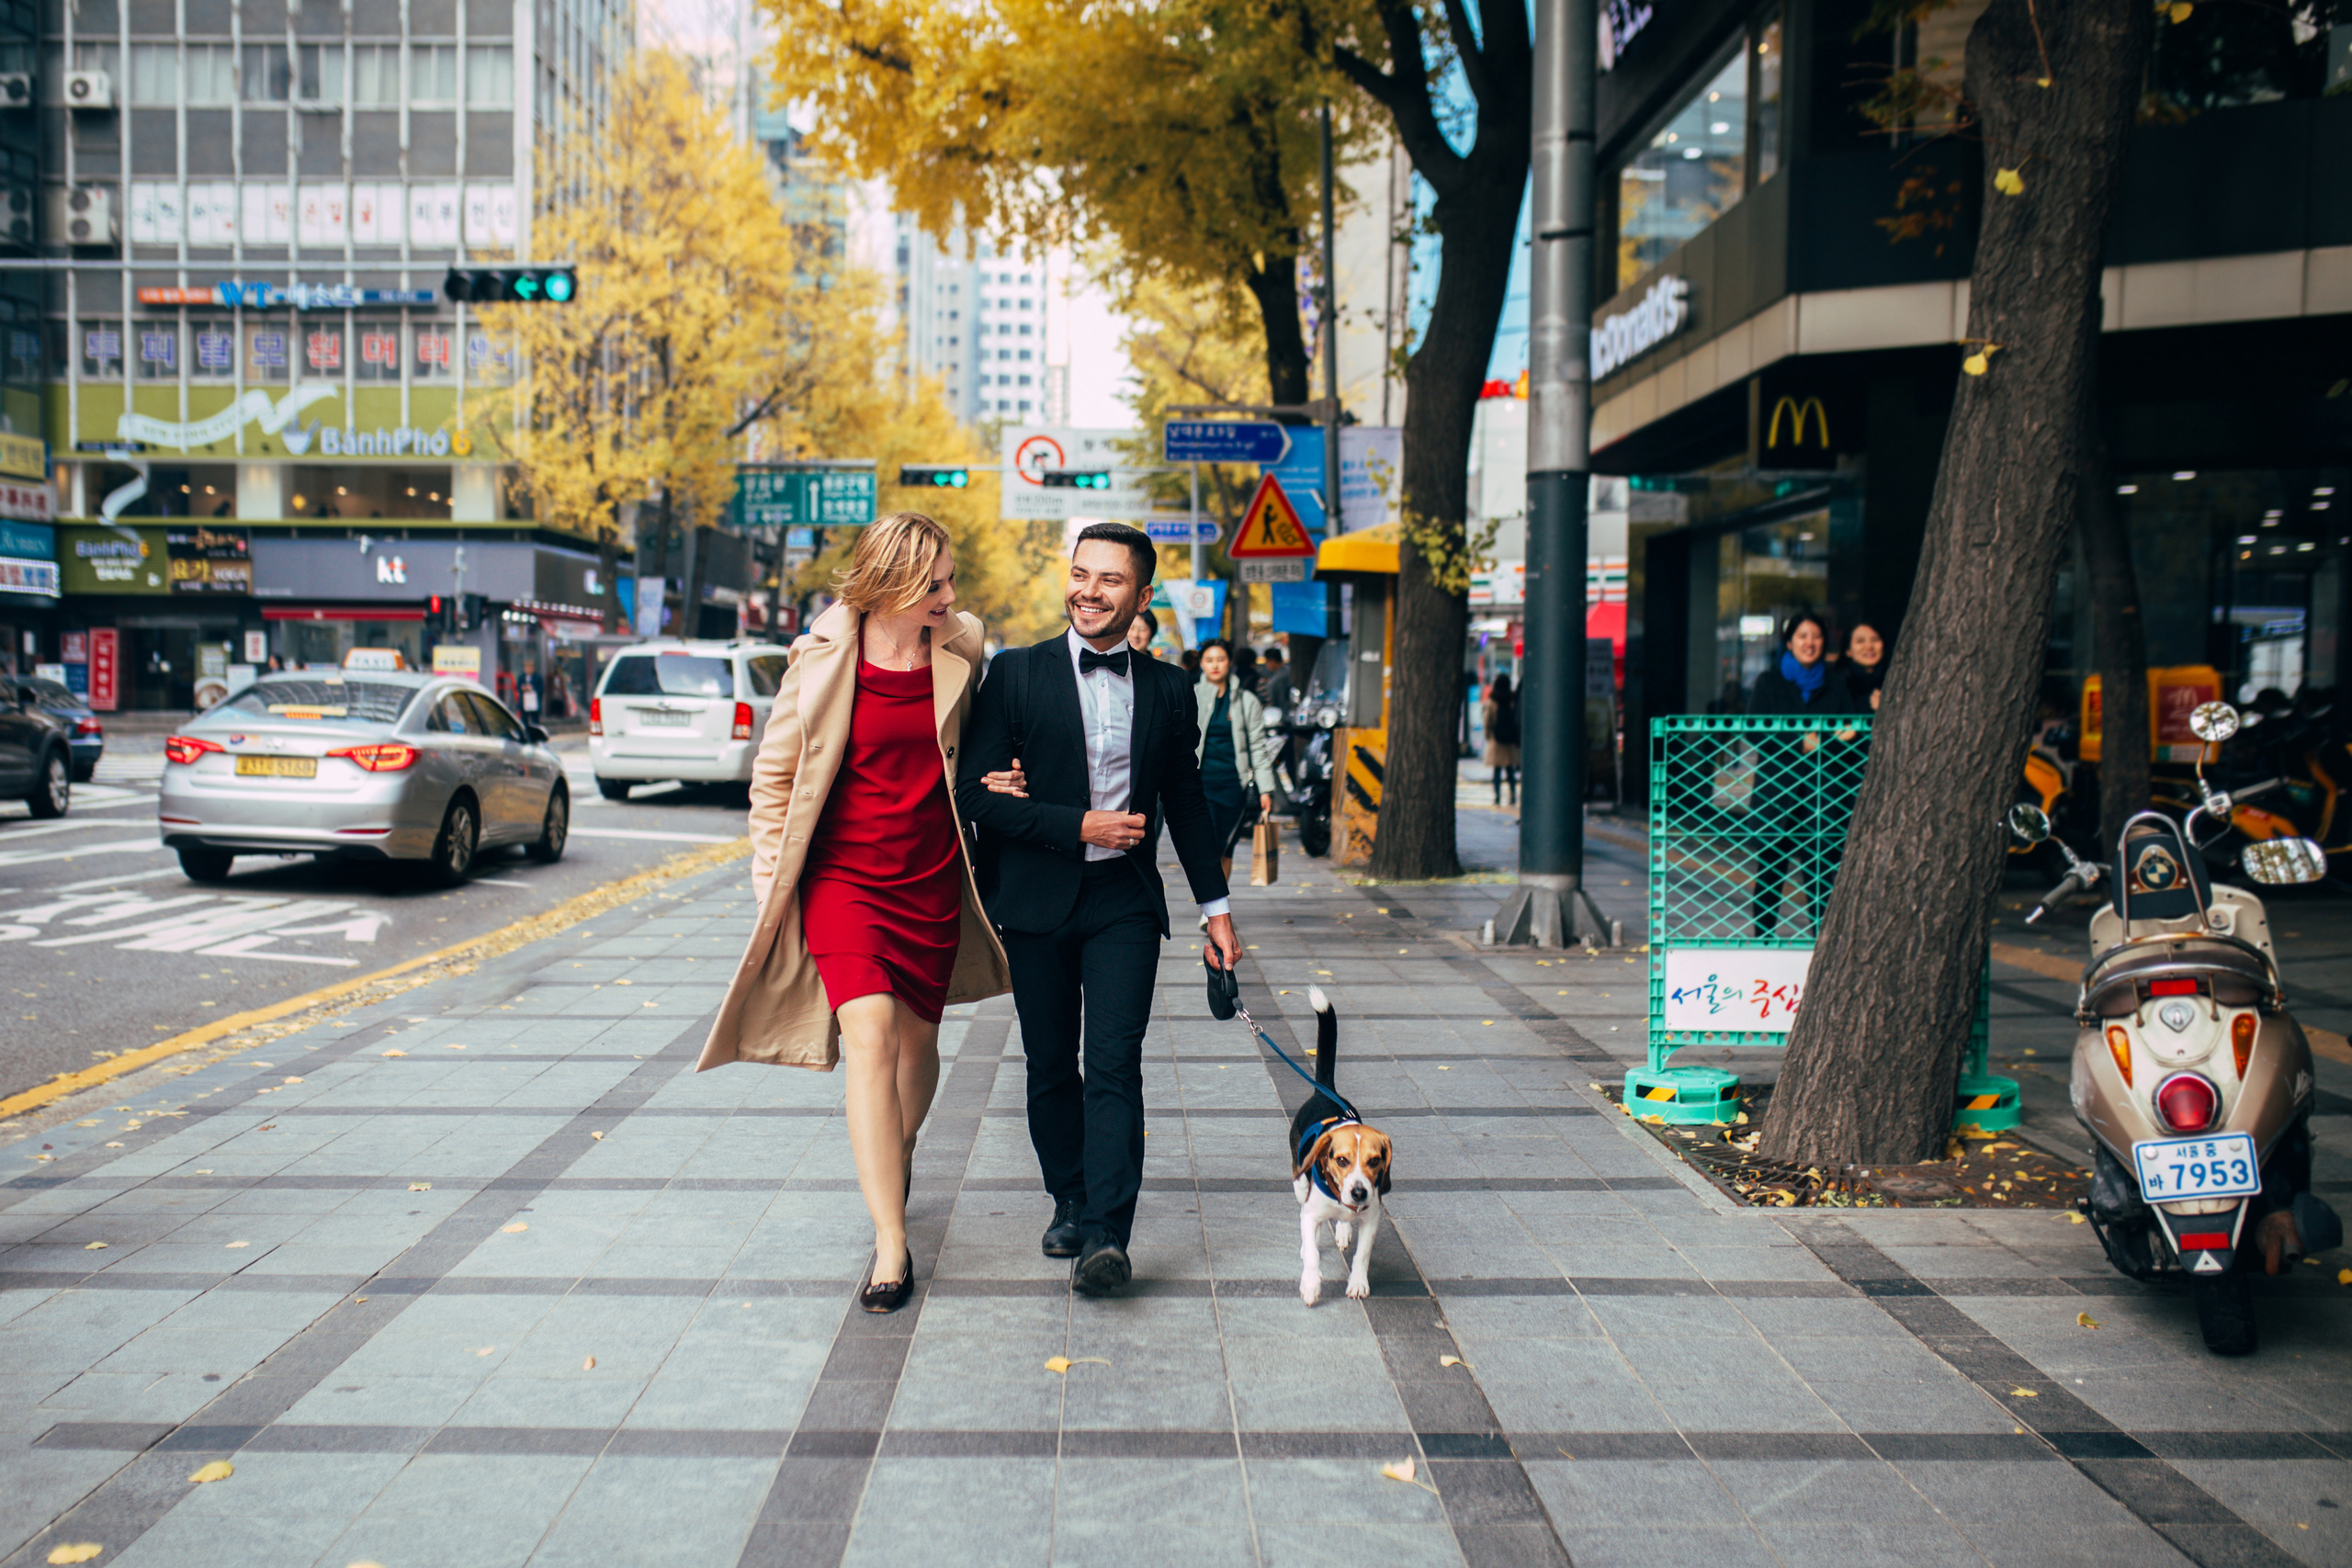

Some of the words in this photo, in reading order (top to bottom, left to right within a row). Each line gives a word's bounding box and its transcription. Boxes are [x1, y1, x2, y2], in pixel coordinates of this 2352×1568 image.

[377, 555, 406, 583] kt
[1671, 974, 1743, 1014] 서울의
[2177, 1145, 2199, 1157] 서울
[2149, 1174, 2164, 1190] 바
[2169, 1159, 2249, 1190] 7953
